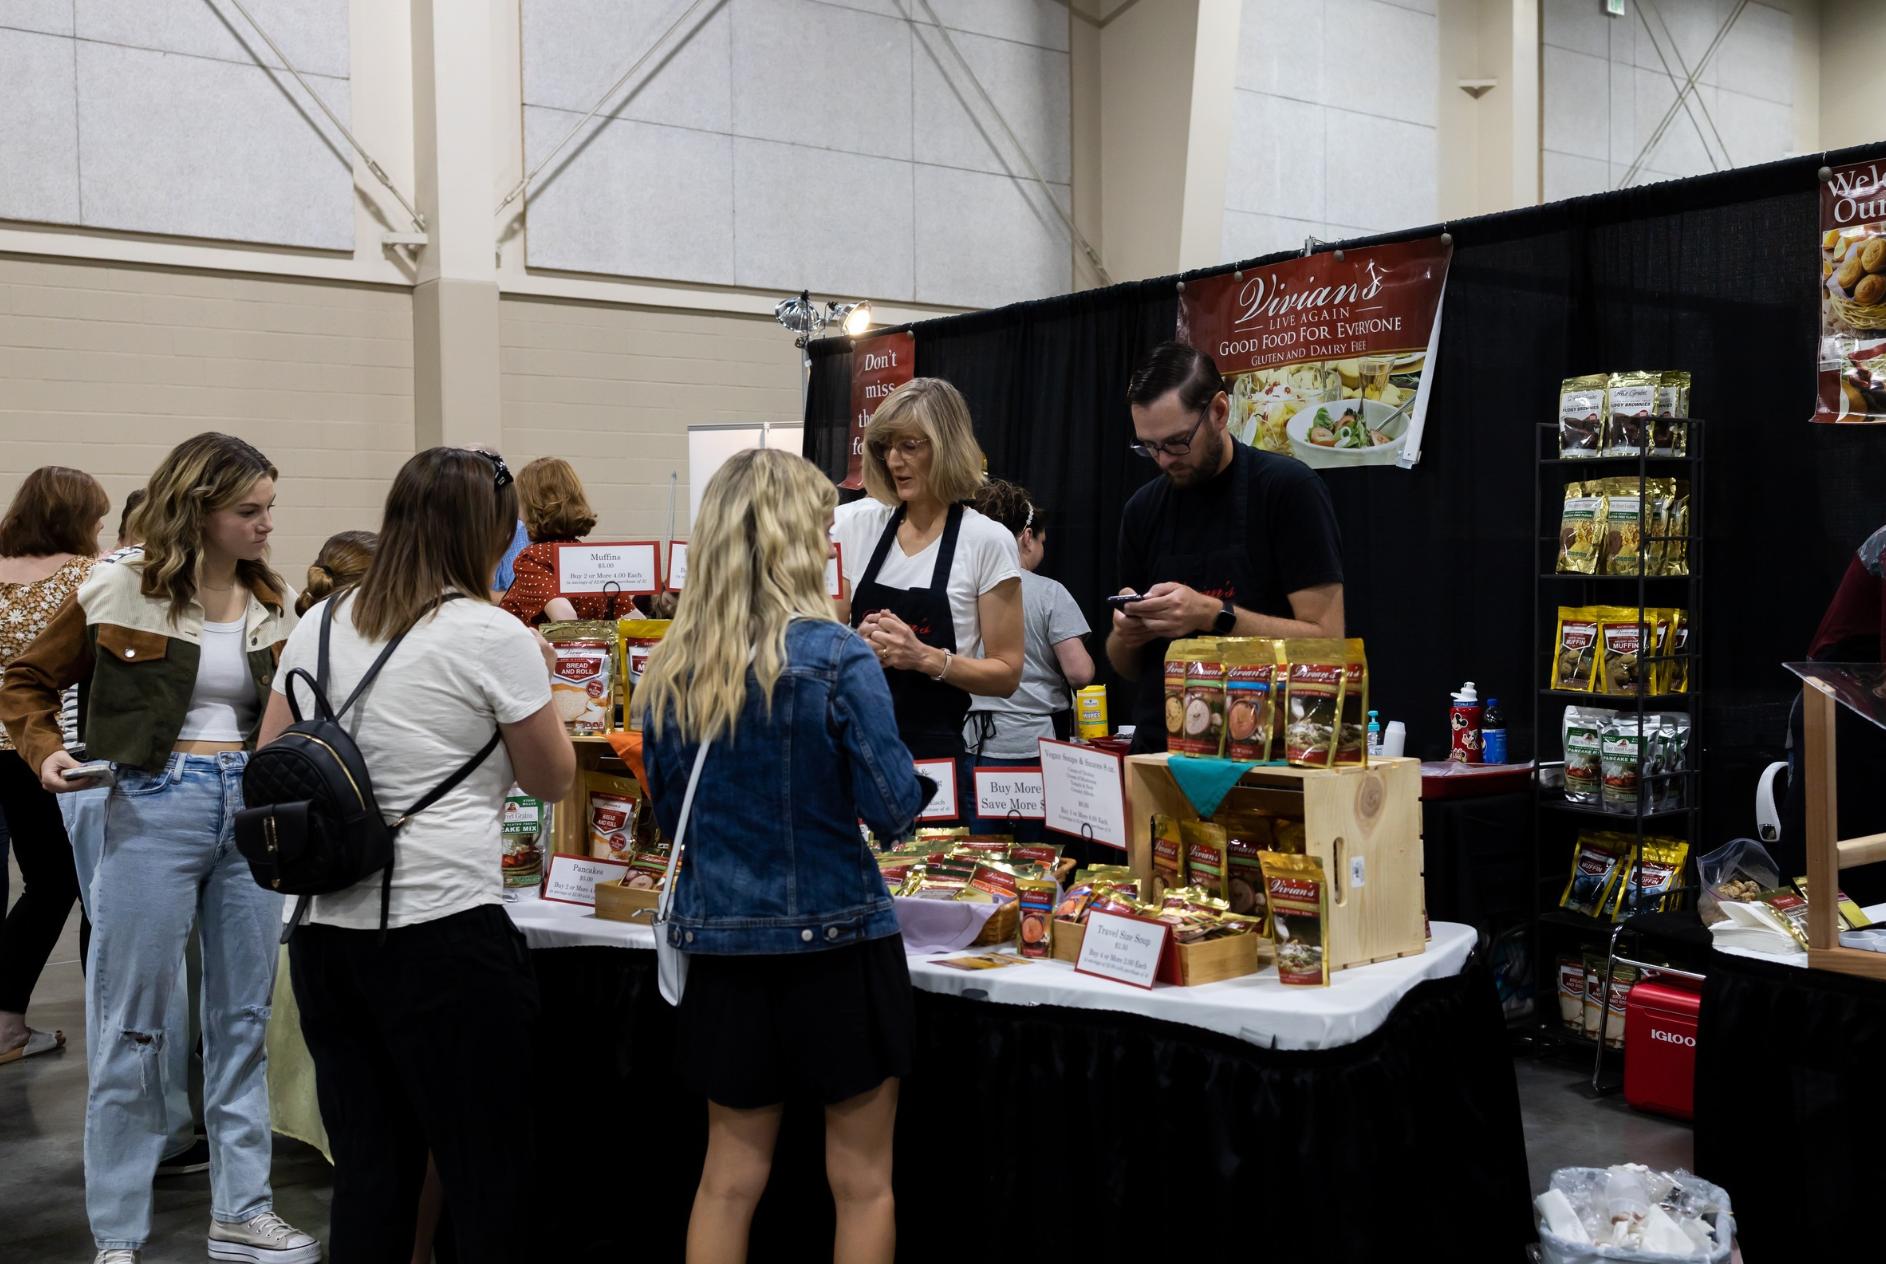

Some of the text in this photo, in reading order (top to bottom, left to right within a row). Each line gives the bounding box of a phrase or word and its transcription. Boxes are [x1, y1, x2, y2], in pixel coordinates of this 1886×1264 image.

[1269, 306, 1350, 331] LIVE AGAIN
[1219, 317, 1402, 356] GOOD FOOD FOR EVERYONE
[865, 349, 898, 372] Don't
[1251, 353, 1284, 367] GLUTEN
[1286, 348, 1306, 361] AND
[1310, 343, 1347, 357] DAIRY
[865, 380, 896, 399] miss
[590, 553, 621, 561] Muffins
[990, 781, 1042, 796] Buy More
[981, 799, 1007, 810] Save
[1010, 799, 1038, 810] More
[573, 863, 604, 875] Pancakes
[1269, 879, 1315, 898] Vivian's
[1098, 924, 1152, 948] Travel Size Soup
[1651, 1028, 1697, 1048] IGLOO
